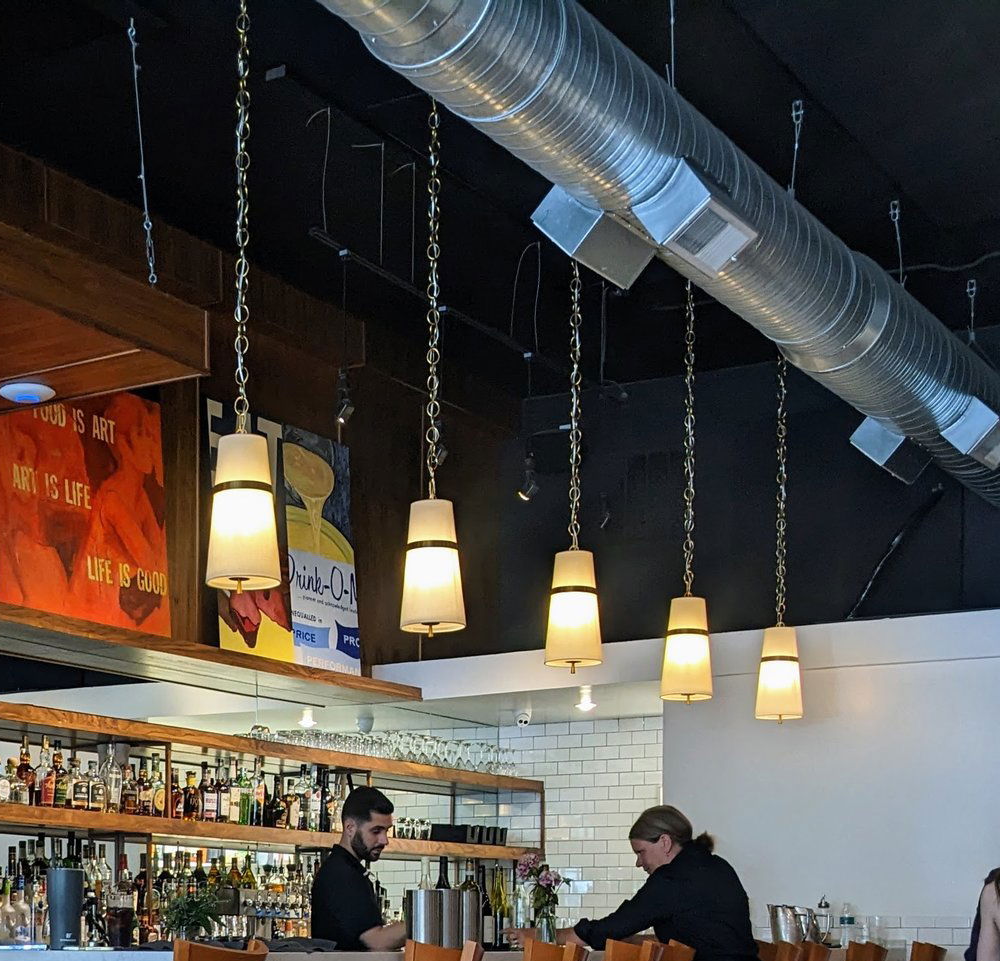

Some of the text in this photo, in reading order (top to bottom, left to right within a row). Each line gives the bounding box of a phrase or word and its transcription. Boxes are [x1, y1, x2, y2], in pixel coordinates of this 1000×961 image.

[72, 408, 85, 433] IS
[92, 415, 115, 444] ART
[13, 463, 92, 510] ART IS LIFE
[87, 555, 168, 596] LIFE IS GOOD
